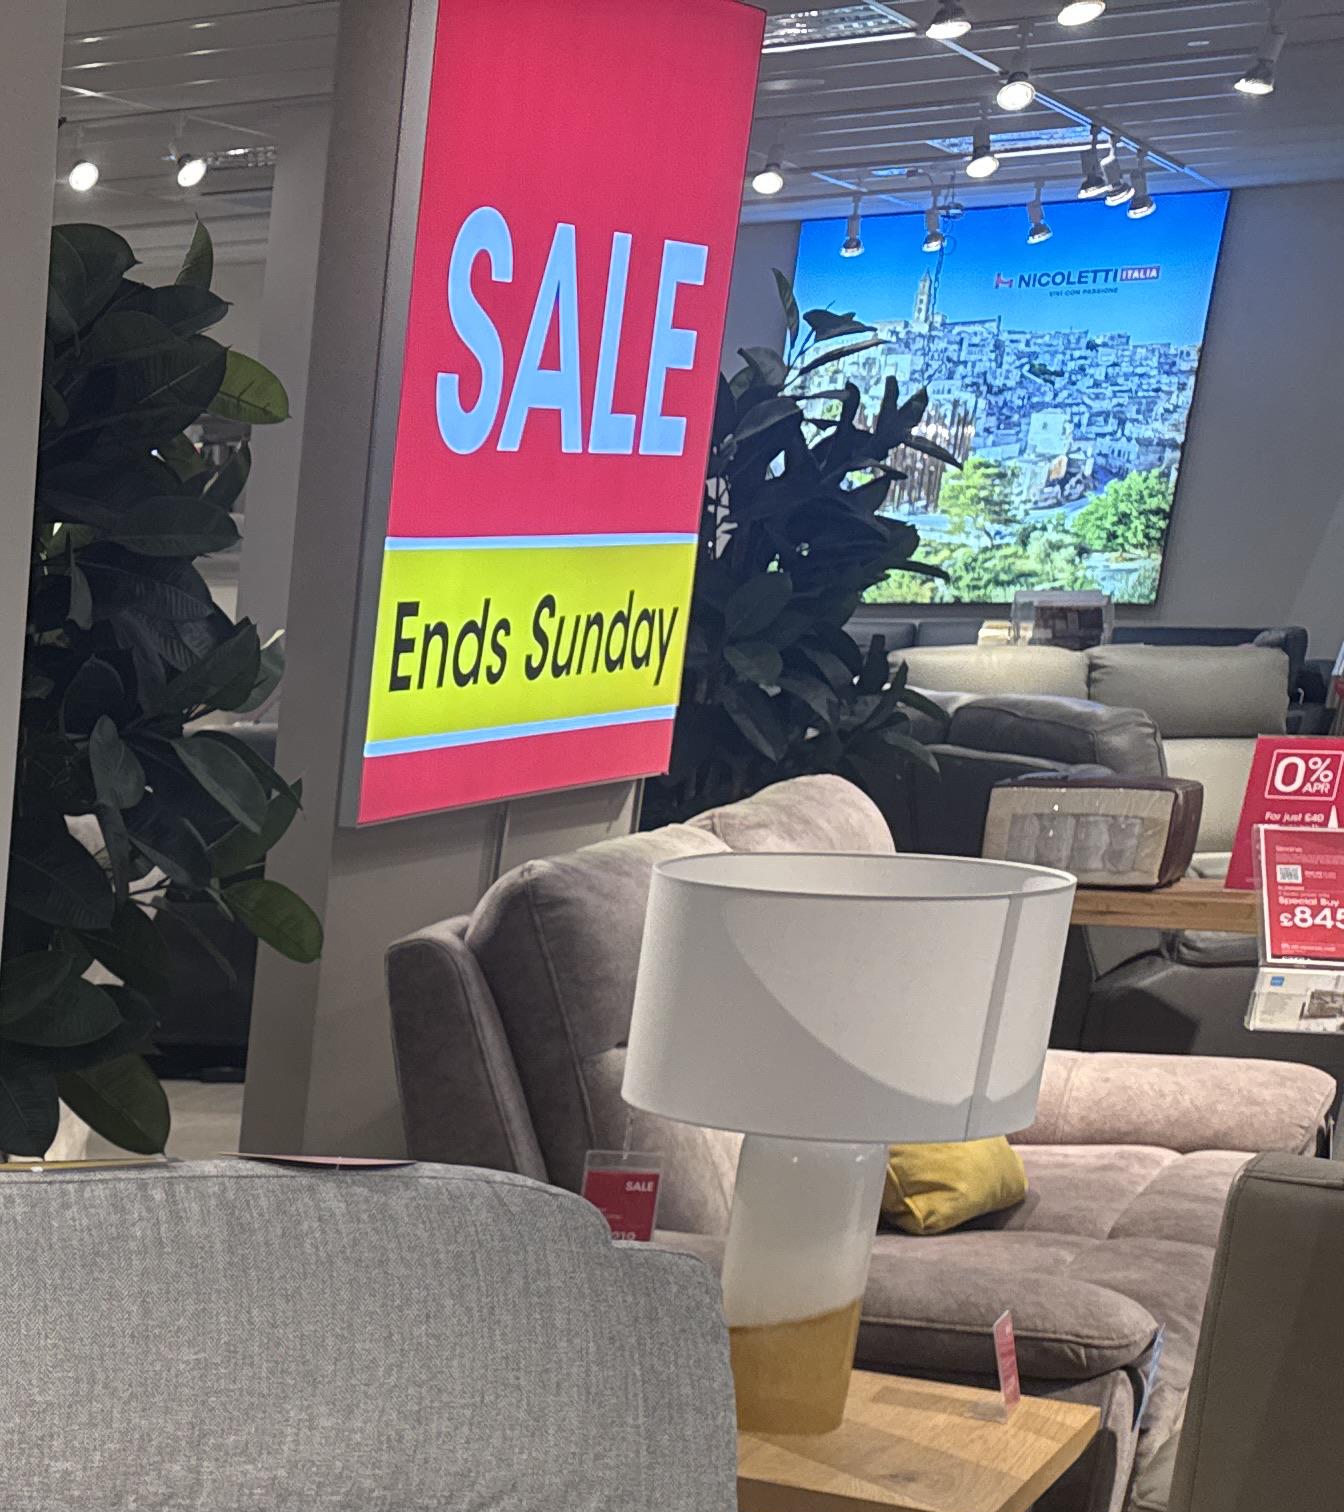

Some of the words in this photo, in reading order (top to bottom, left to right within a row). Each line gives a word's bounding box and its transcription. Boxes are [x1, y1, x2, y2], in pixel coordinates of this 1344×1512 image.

[1017, 268, 1119, 289] NICOLETTI
[1122, 266, 1160, 281] ITALIA
[436, 206, 708, 456] SALE
[389, 597, 511, 692] Ends
[525, 590, 679, 687] Sunday
[1274, 756, 1333, 793] 0%
[1302, 782, 1330, 794] APR
[1278, 896, 1318, 905] Special
[1320, 897, 1340, 908] Buy
[625, 1181, 654, 1192] SALE
